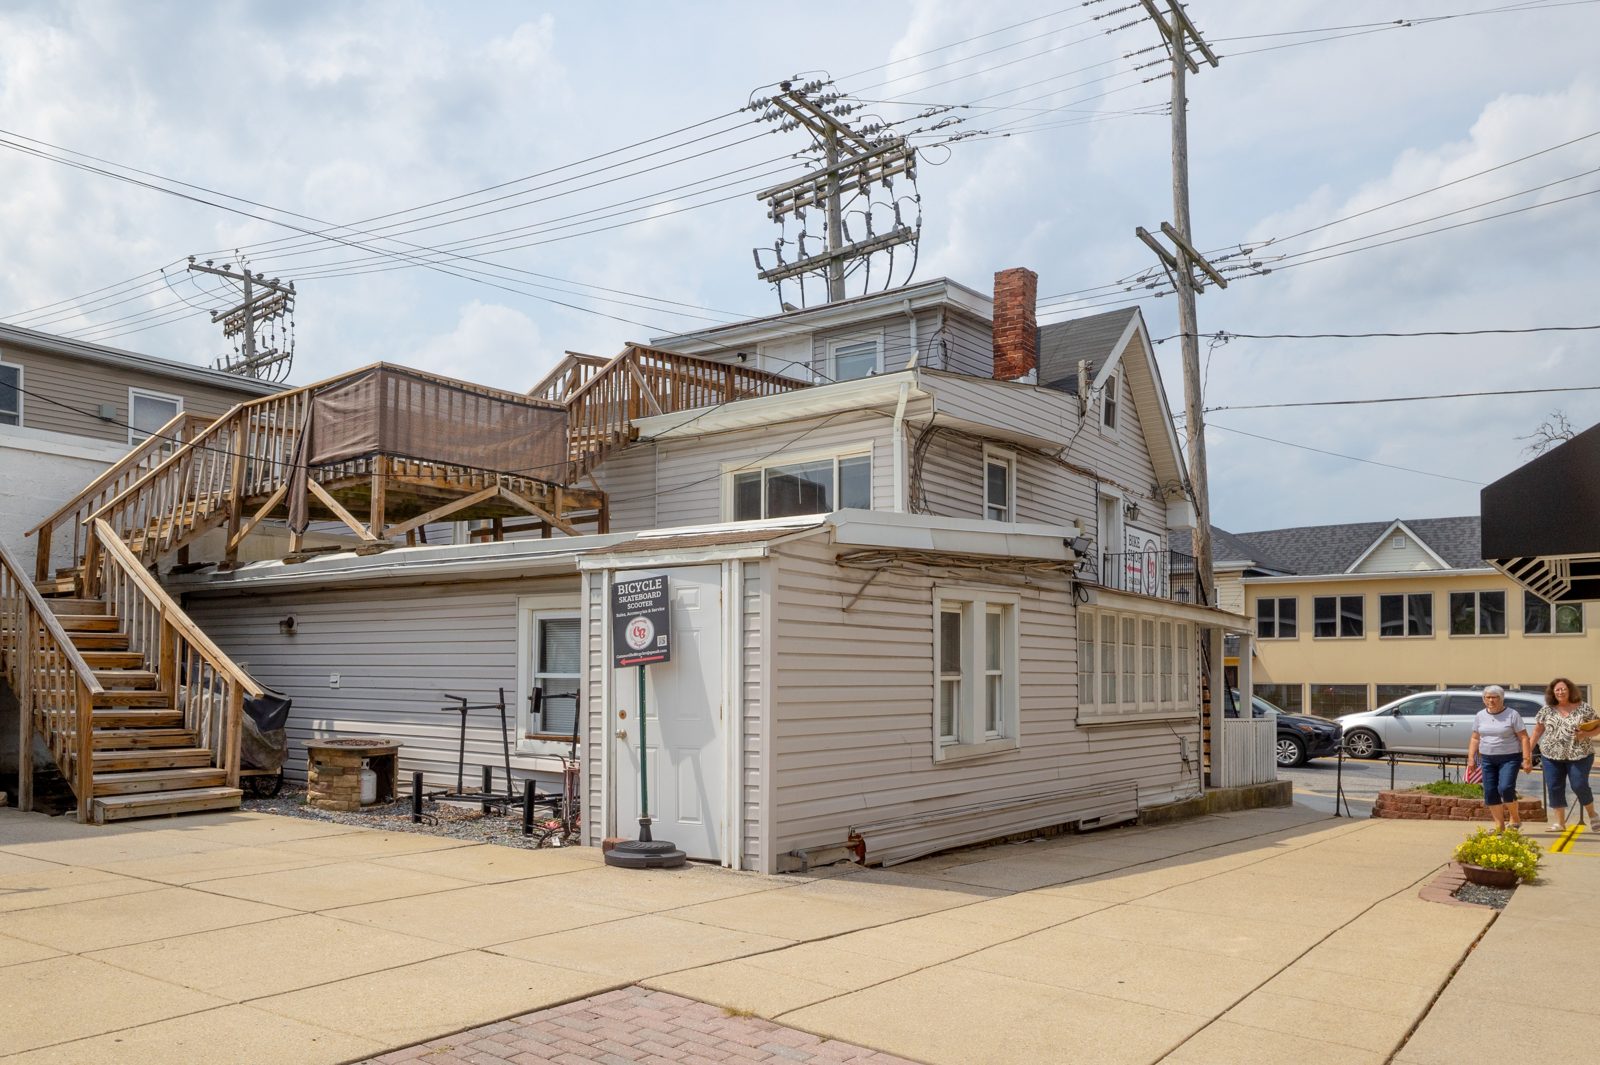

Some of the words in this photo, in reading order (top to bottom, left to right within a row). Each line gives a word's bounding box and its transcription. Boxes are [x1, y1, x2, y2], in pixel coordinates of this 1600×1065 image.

[1128, 534, 1140, 548] BIKE
[617, 578, 662, 595] BICYCLE
[618, 591, 662, 603] SKATEBOARD
[627, 600, 653, 610] SCOOTER
